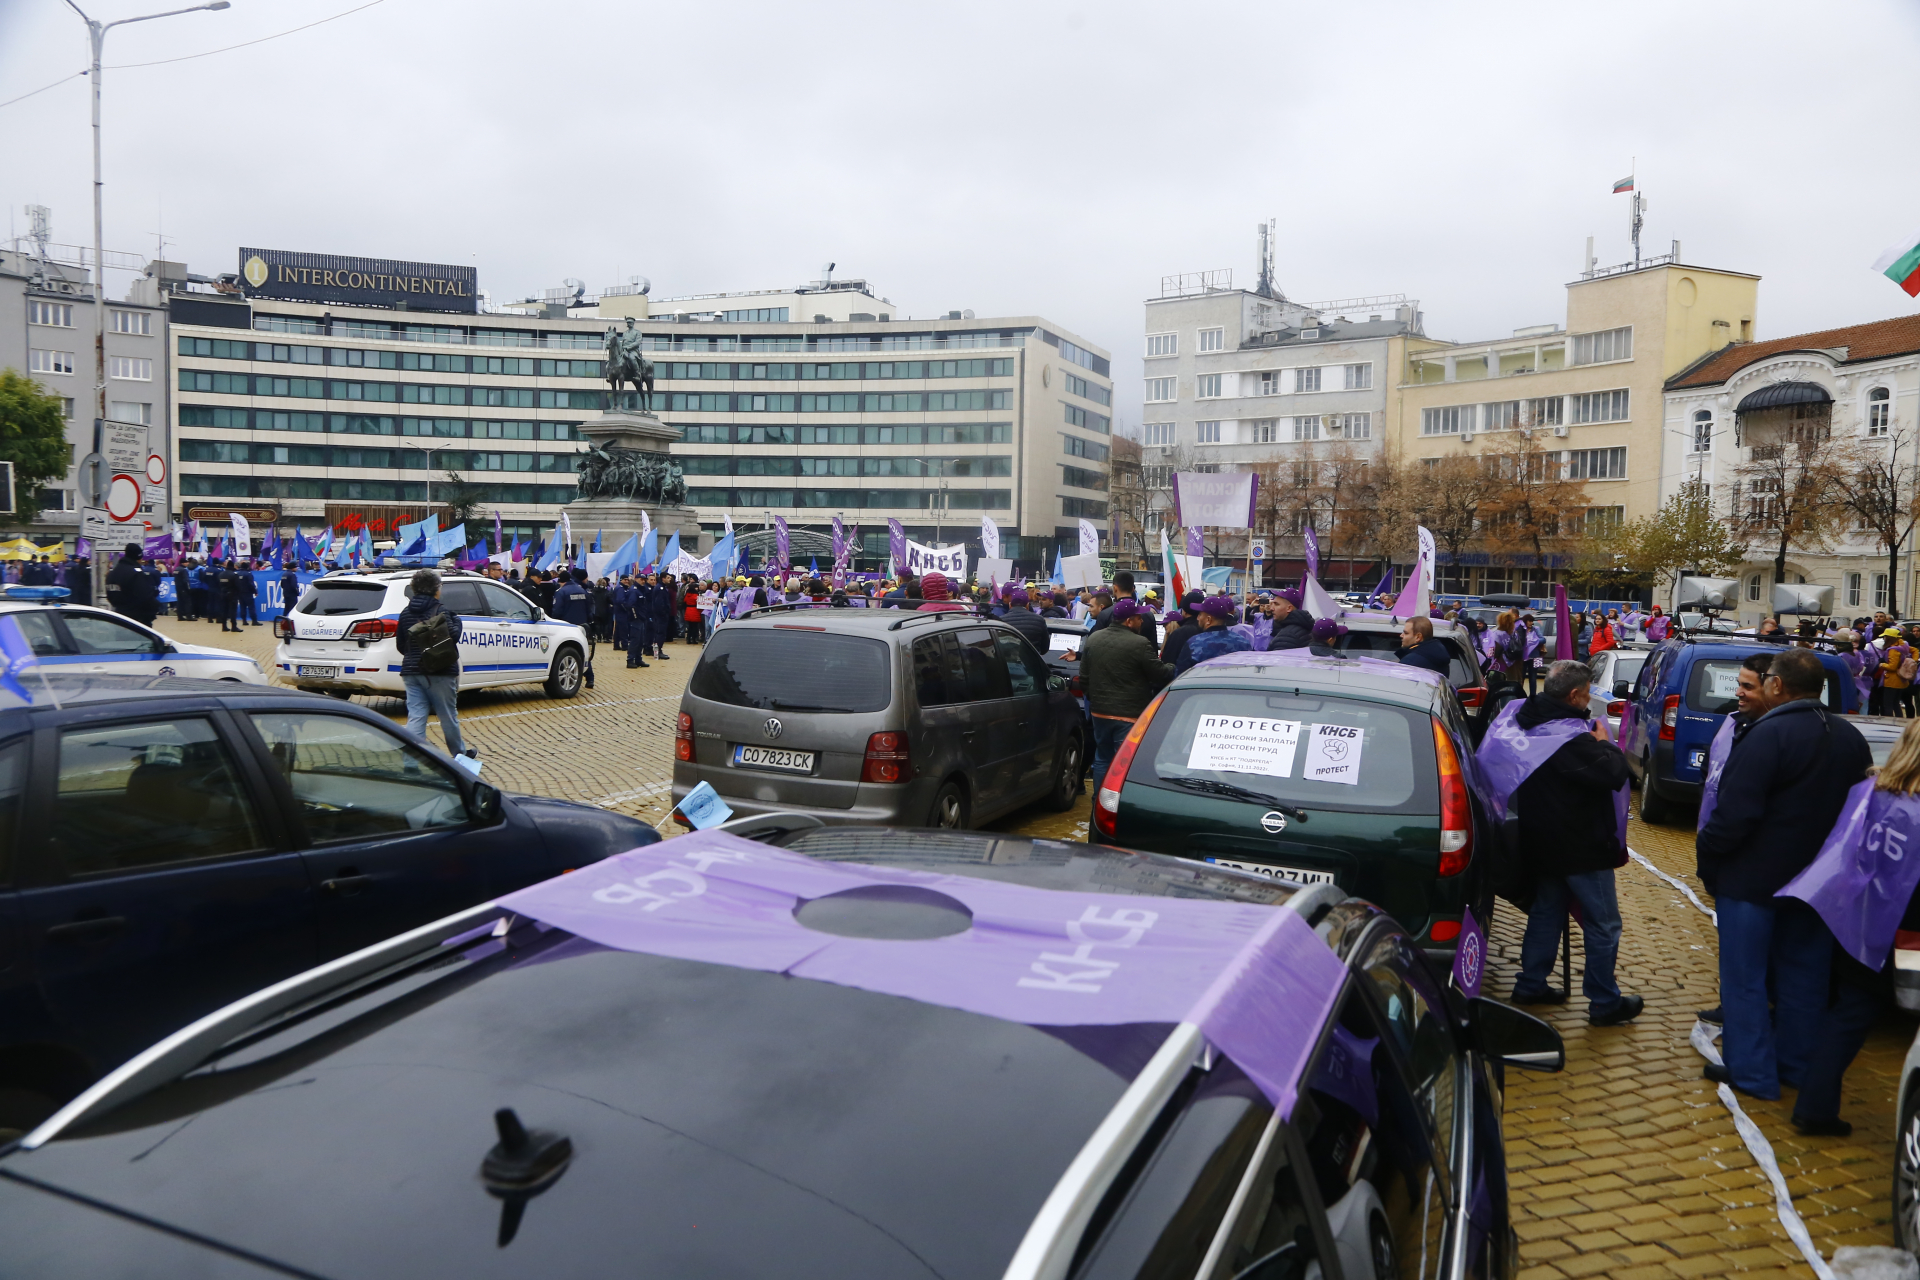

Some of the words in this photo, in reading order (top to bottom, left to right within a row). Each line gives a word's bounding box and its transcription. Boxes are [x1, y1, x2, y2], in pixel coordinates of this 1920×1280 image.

[278, 264, 467, 297] INTERCONTINENTAL
[909, 548, 962, 572] КНСБ
[458, 632, 540, 650] АНДАРМЕРИЯ
[1206, 718, 1294, 733] ПРОТЕСТ
[1318, 726, 1358, 738] КНСБ
[1210, 734, 1256, 742] ПО-ВИСОКИ
[1258, 736, 1296, 745] ЗАПЛАТИ
[1218, 744, 1256, 752] ДОСТОЕН
[744, 748, 760, 762] CO
[761, 750, 792, 766] 7823
[794, 754, 810, 768] CK
[1316, 766, 1350, 775] ПРОТЕСТ
[1016, 905, 1159, 994] КНСБ
